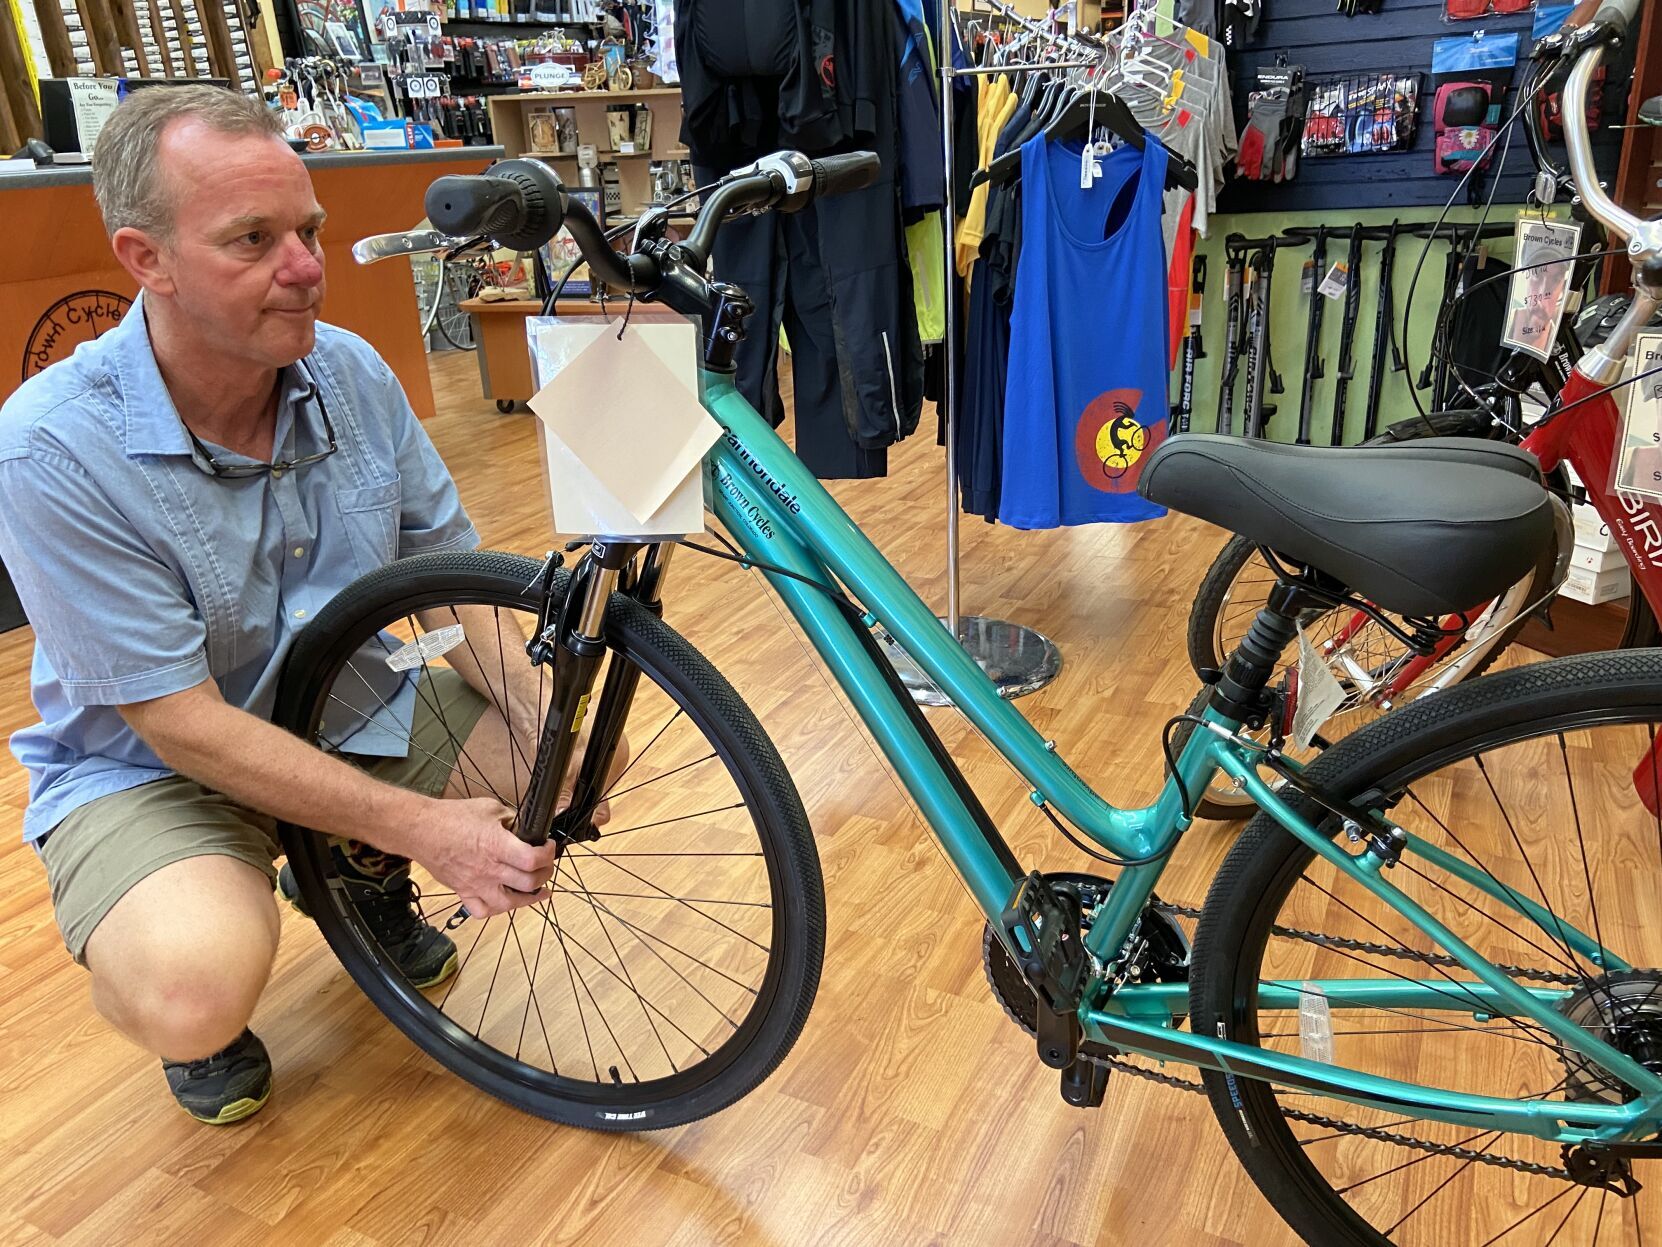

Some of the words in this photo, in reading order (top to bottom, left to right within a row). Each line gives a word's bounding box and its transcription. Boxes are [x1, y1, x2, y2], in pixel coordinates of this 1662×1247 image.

[73, 82, 97, 90] Before
[98, 82, 113, 90] You
[1523, 233, 1543, 243] Brown
[1544, 236, 1563, 247] Cycles
[719, 473, 750, 509] Brown
[748, 506, 776, 540] Cycles
[1615, 518, 1628, 537] Easy
[1626, 537, 1647, 571] Boarding
